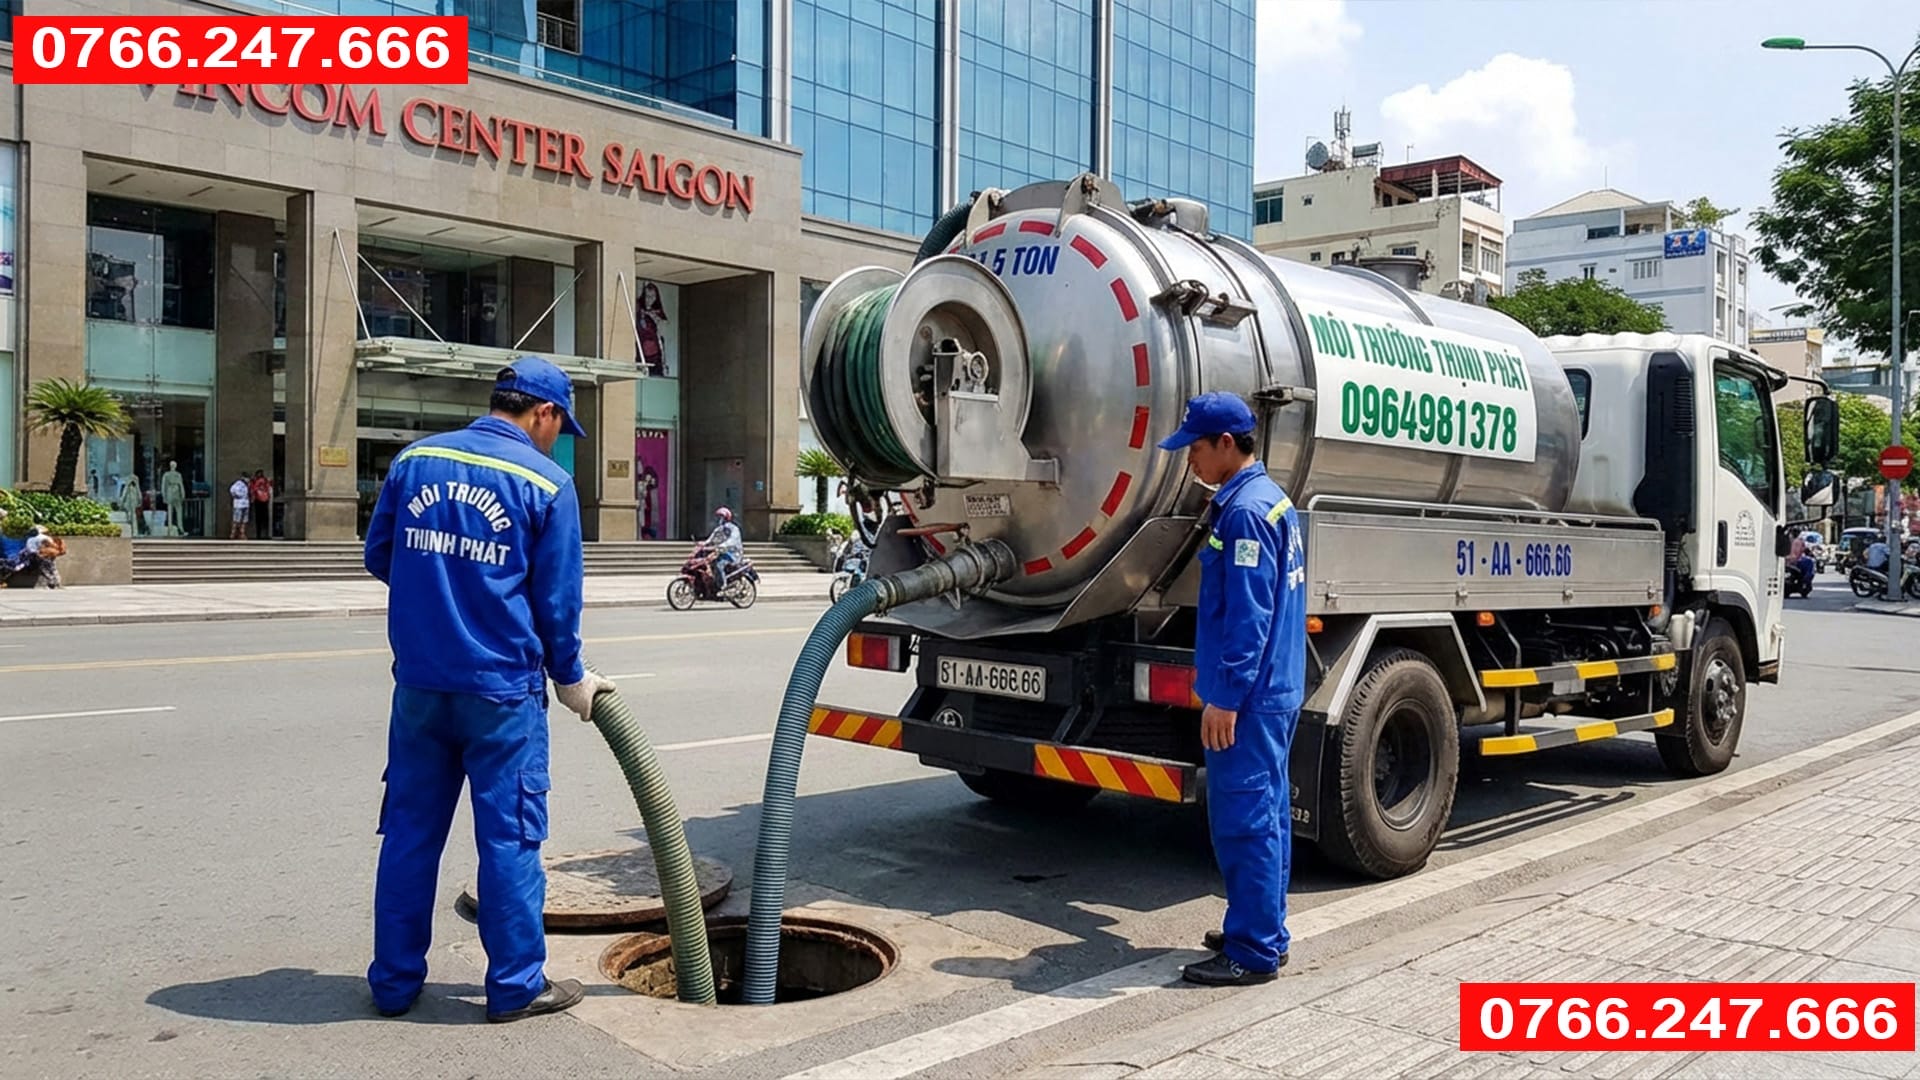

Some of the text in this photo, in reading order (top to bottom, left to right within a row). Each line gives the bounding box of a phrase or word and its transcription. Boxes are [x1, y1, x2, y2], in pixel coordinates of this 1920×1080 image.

[401, 97, 594, 181] CENTER
[602, 142, 755, 214] SAIGON
[1011, 245, 1061, 276] TON
[1341, 380, 1517, 453] 0964981378
